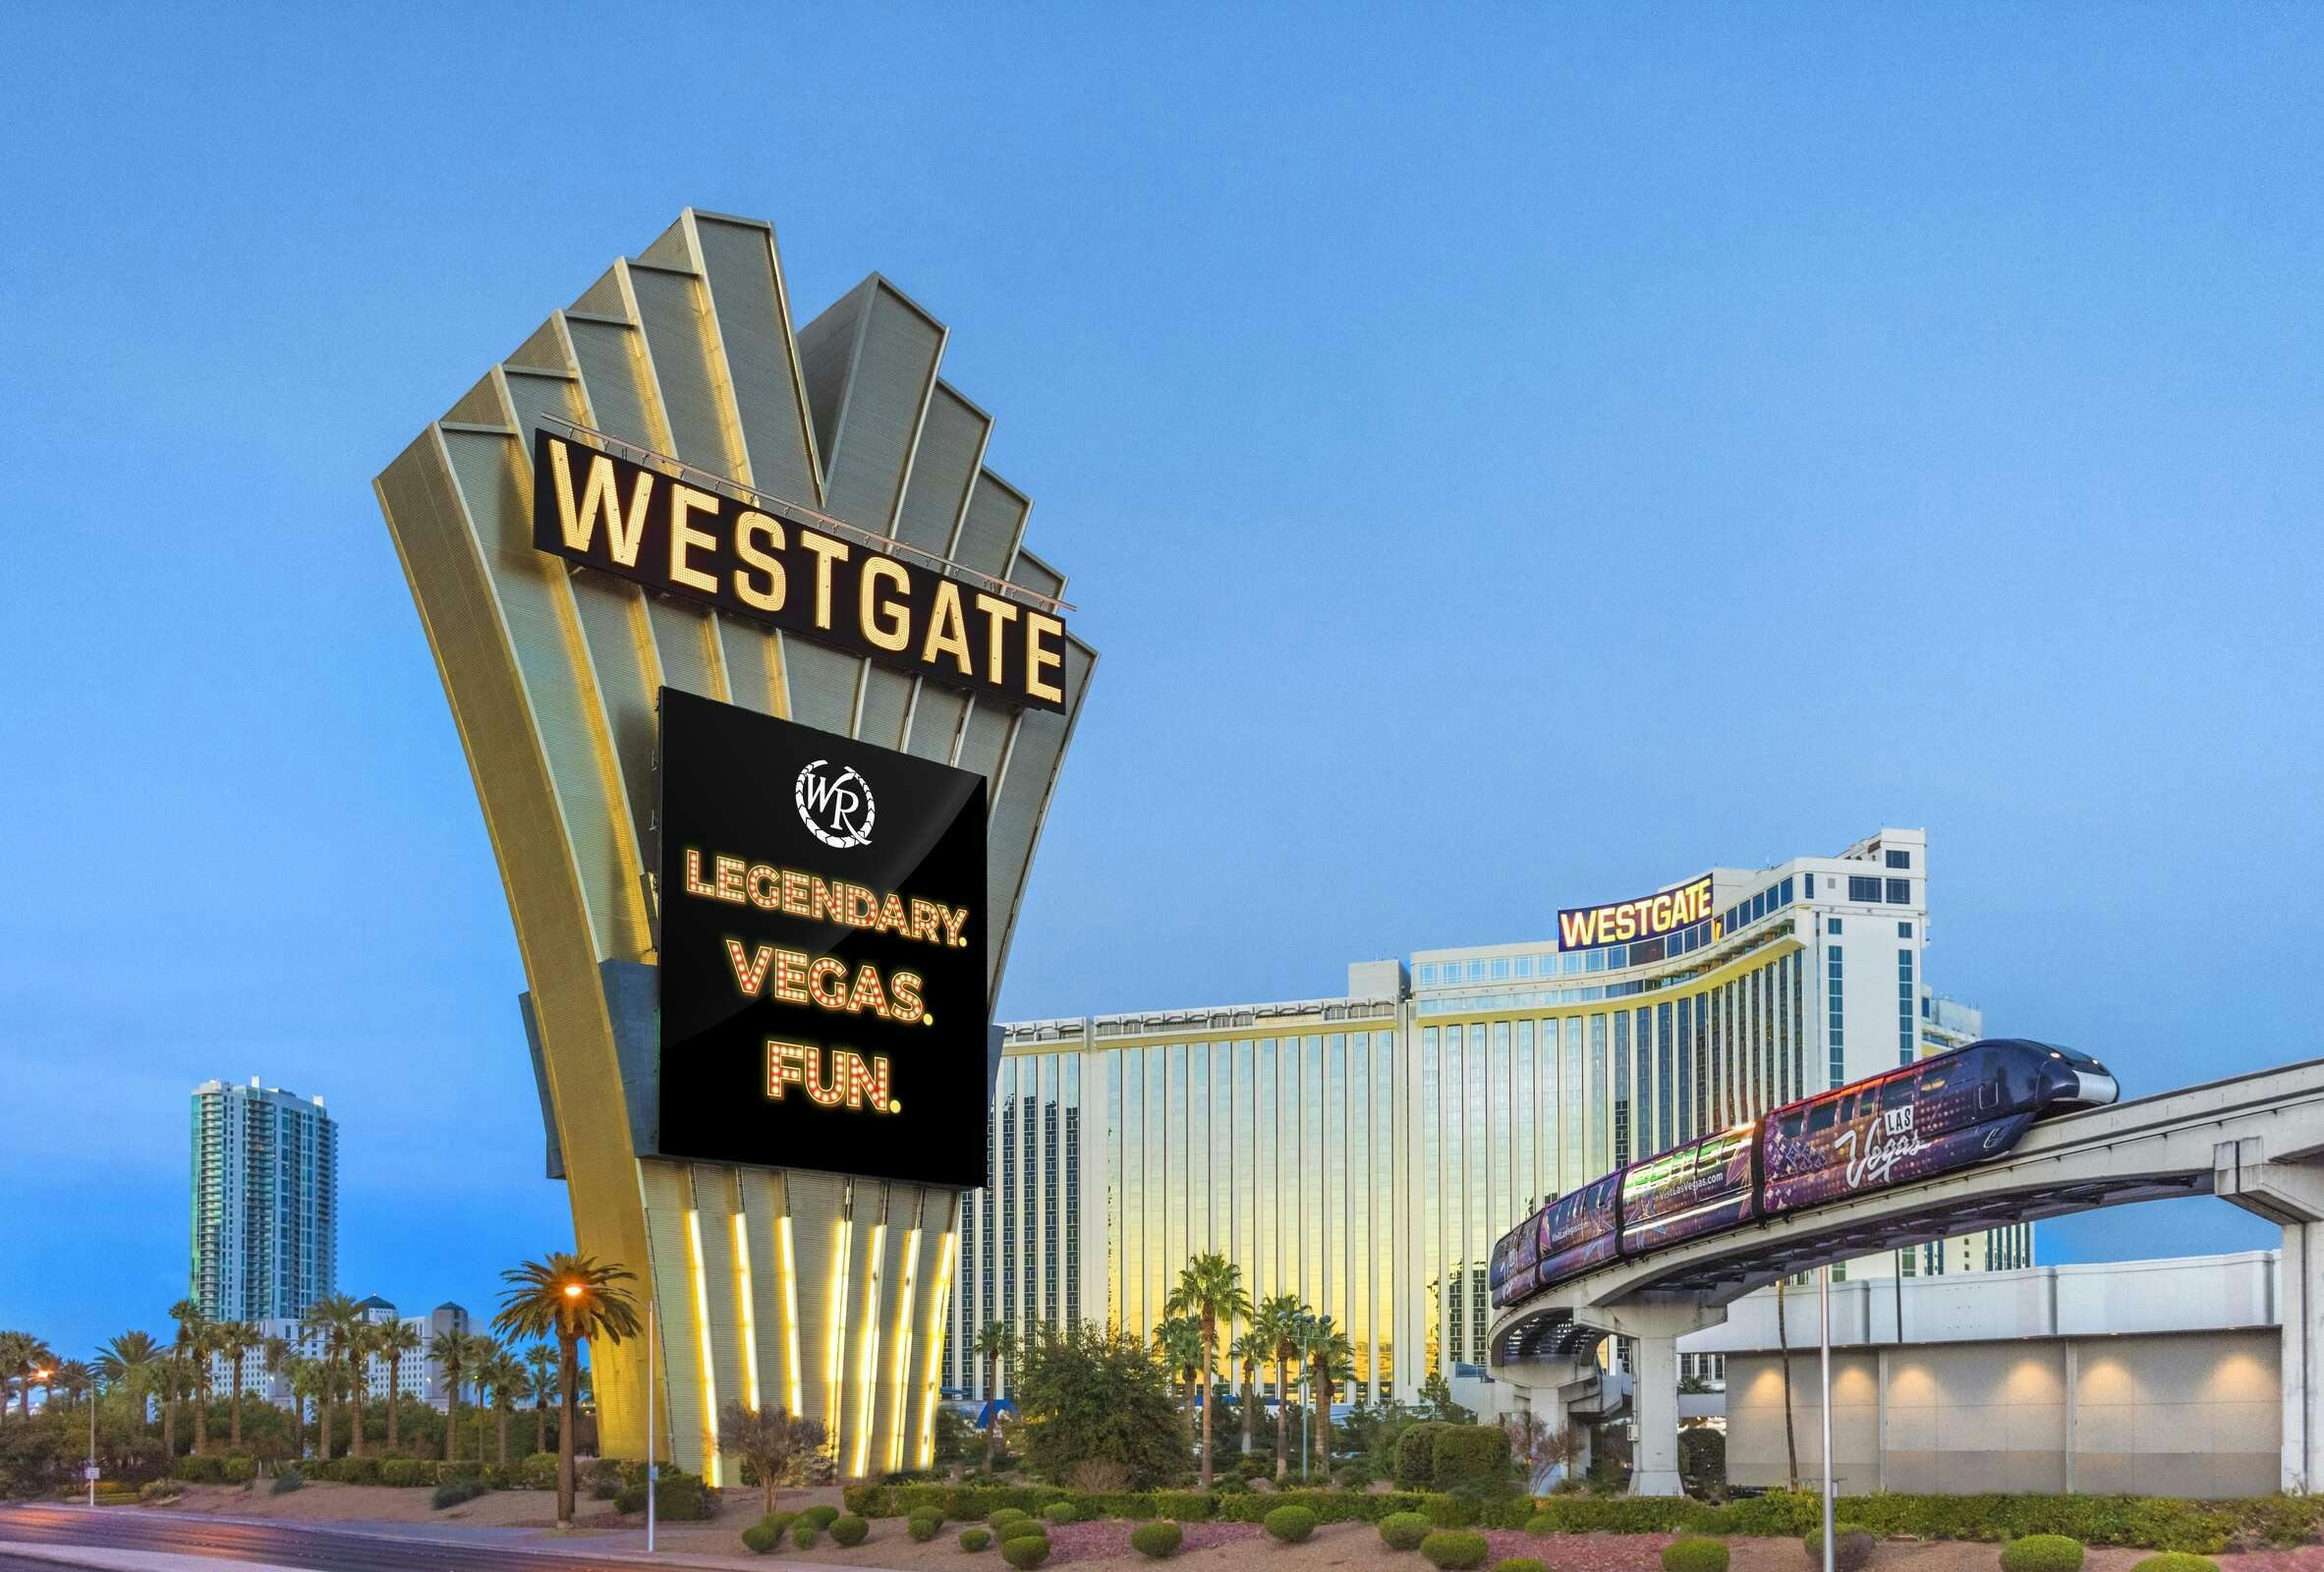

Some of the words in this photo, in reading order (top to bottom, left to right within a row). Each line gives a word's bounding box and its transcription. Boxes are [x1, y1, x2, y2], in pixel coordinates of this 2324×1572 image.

[548, 439, 1062, 703] WESTGATE
[806, 772, 873, 846] WR
[687, 849, 968, 947] LEGENDARY.
[1559, 878, 1712, 948] WESTGATE
[725, 939, 934, 1026] VEGAS.
[766, 1039, 901, 1113] FUN.
[1834, 1117, 1933, 1189] Vegas
[1887, 1107, 1911, 1133] LAS
